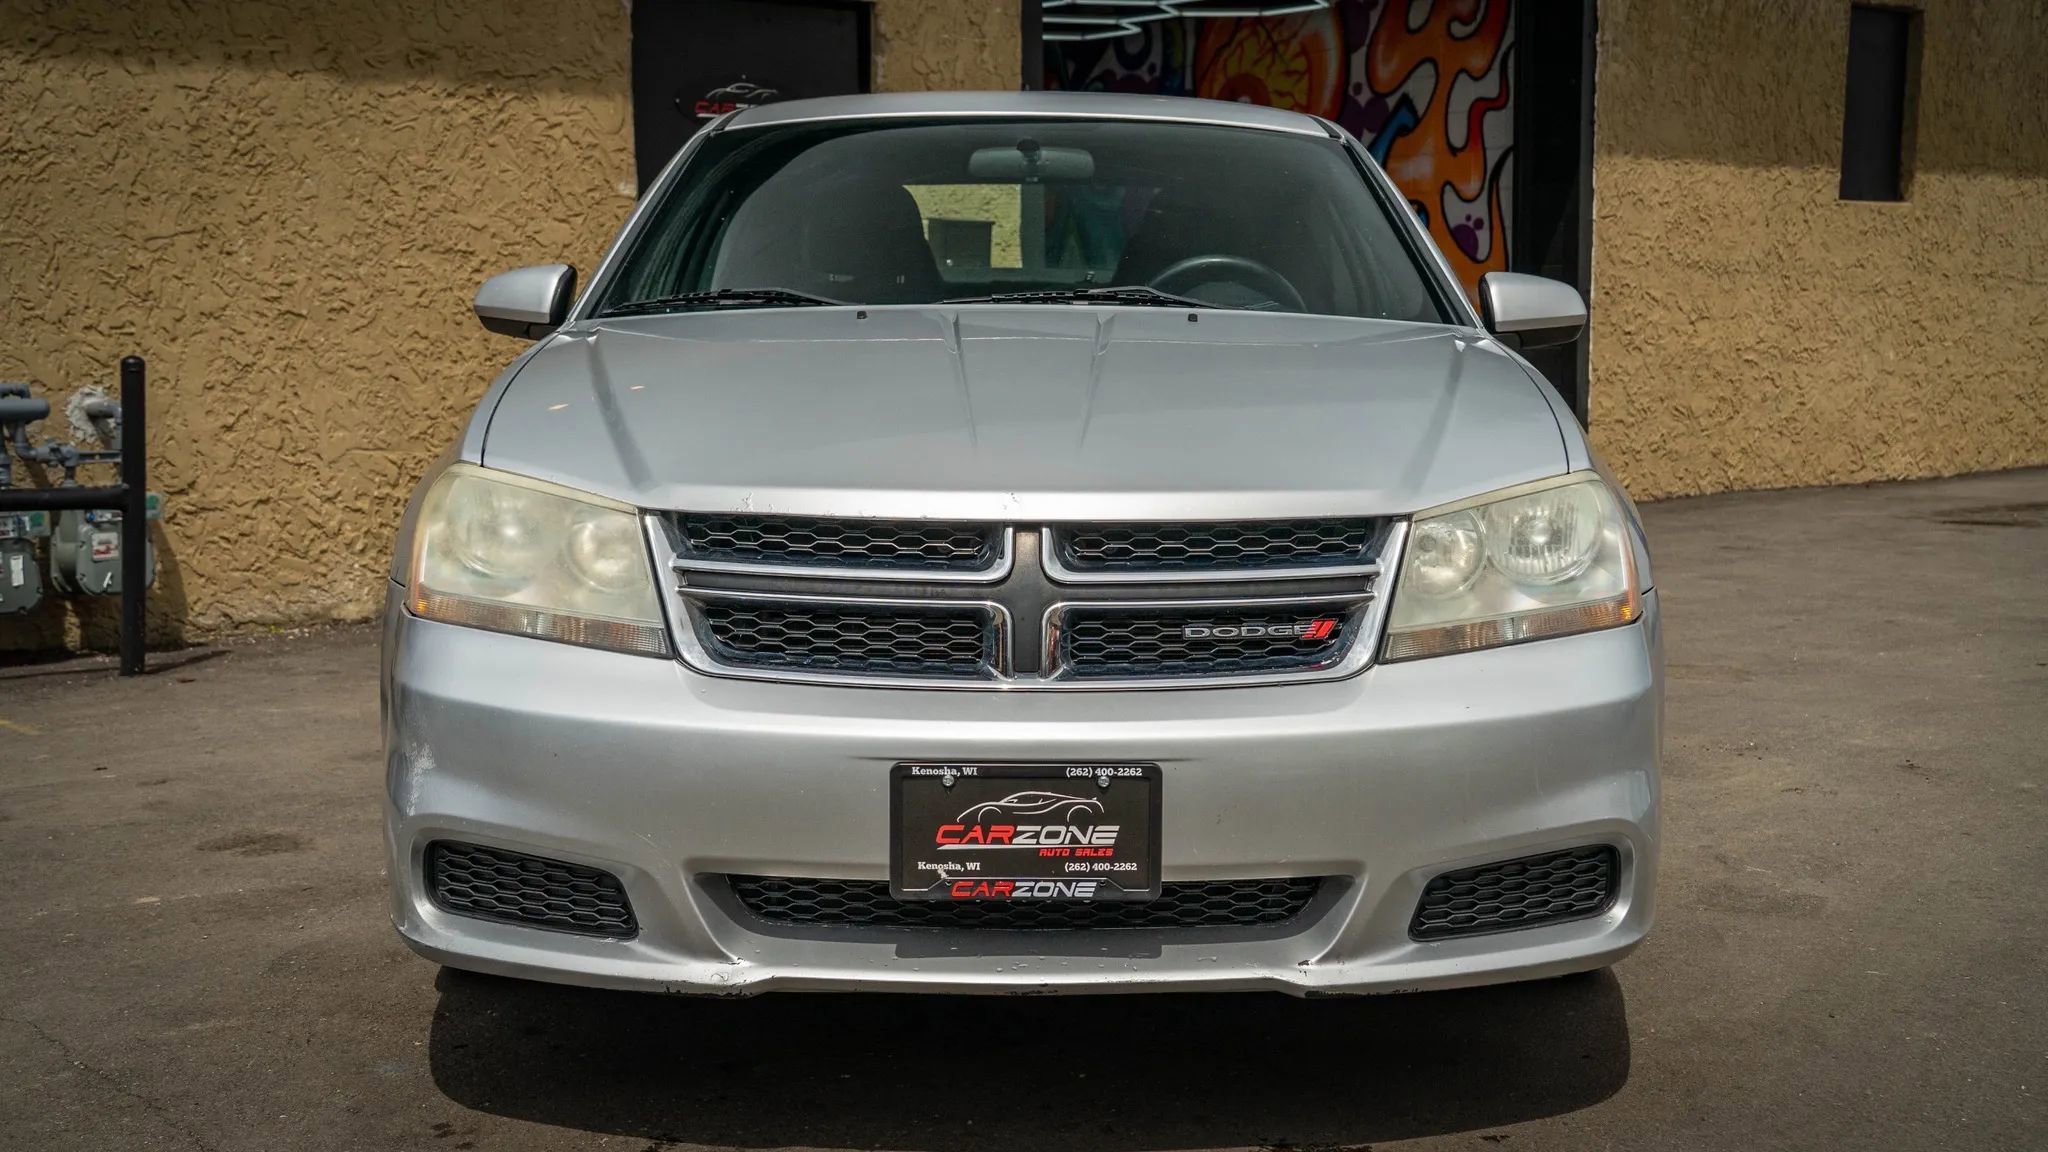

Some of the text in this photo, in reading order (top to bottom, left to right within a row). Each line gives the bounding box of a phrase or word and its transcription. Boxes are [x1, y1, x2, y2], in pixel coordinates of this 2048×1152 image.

[1184, 625, 1316, 638] DODGE
[911, 766, 978, 777] Kenosha, WI
[1065, 766, 1142, 778] (262) 400-2262
[935, 824, 1120, 845] CARZONE
[1039, 848, 1114, 857] AUTO SALES
[917, 861, 981, 872] Kenosha, WI
[1064, 862, 1138, 873] (262) 400-2262
[951, 881, 1097, 898] CARZONE
